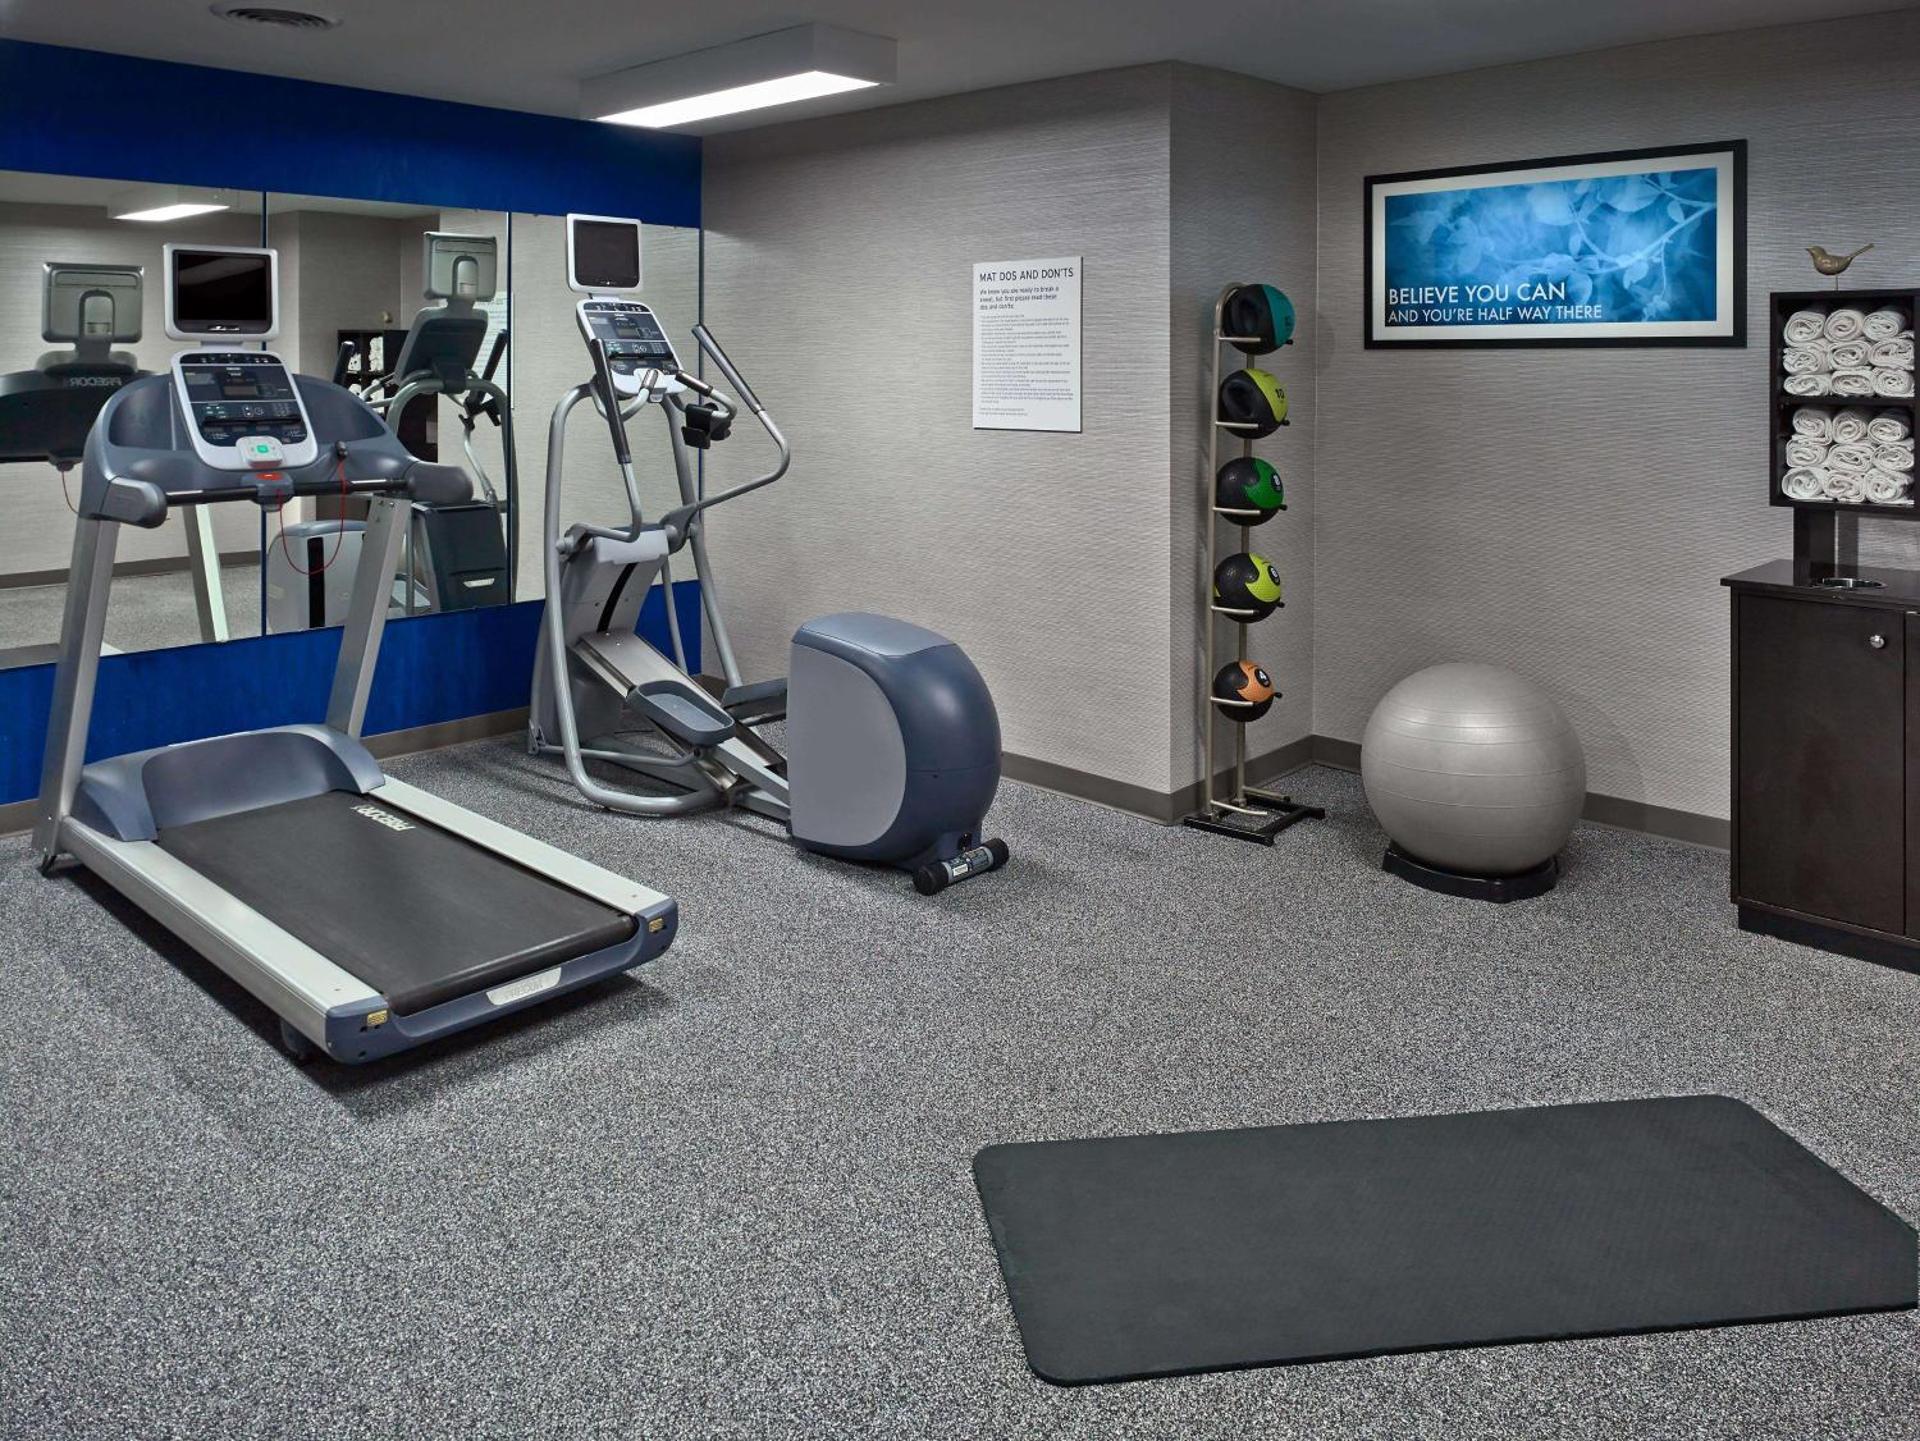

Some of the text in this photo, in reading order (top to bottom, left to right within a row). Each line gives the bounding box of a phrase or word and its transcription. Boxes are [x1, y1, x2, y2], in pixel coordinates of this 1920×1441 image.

[979, 267, 1074, 281] MAT DOS AND DON'TS
[1389, 282, 1565, 305] BELIEVE YOU CAN
[1388, 305, 1602, 323] AND YOU'RE HALF WAY THERE
